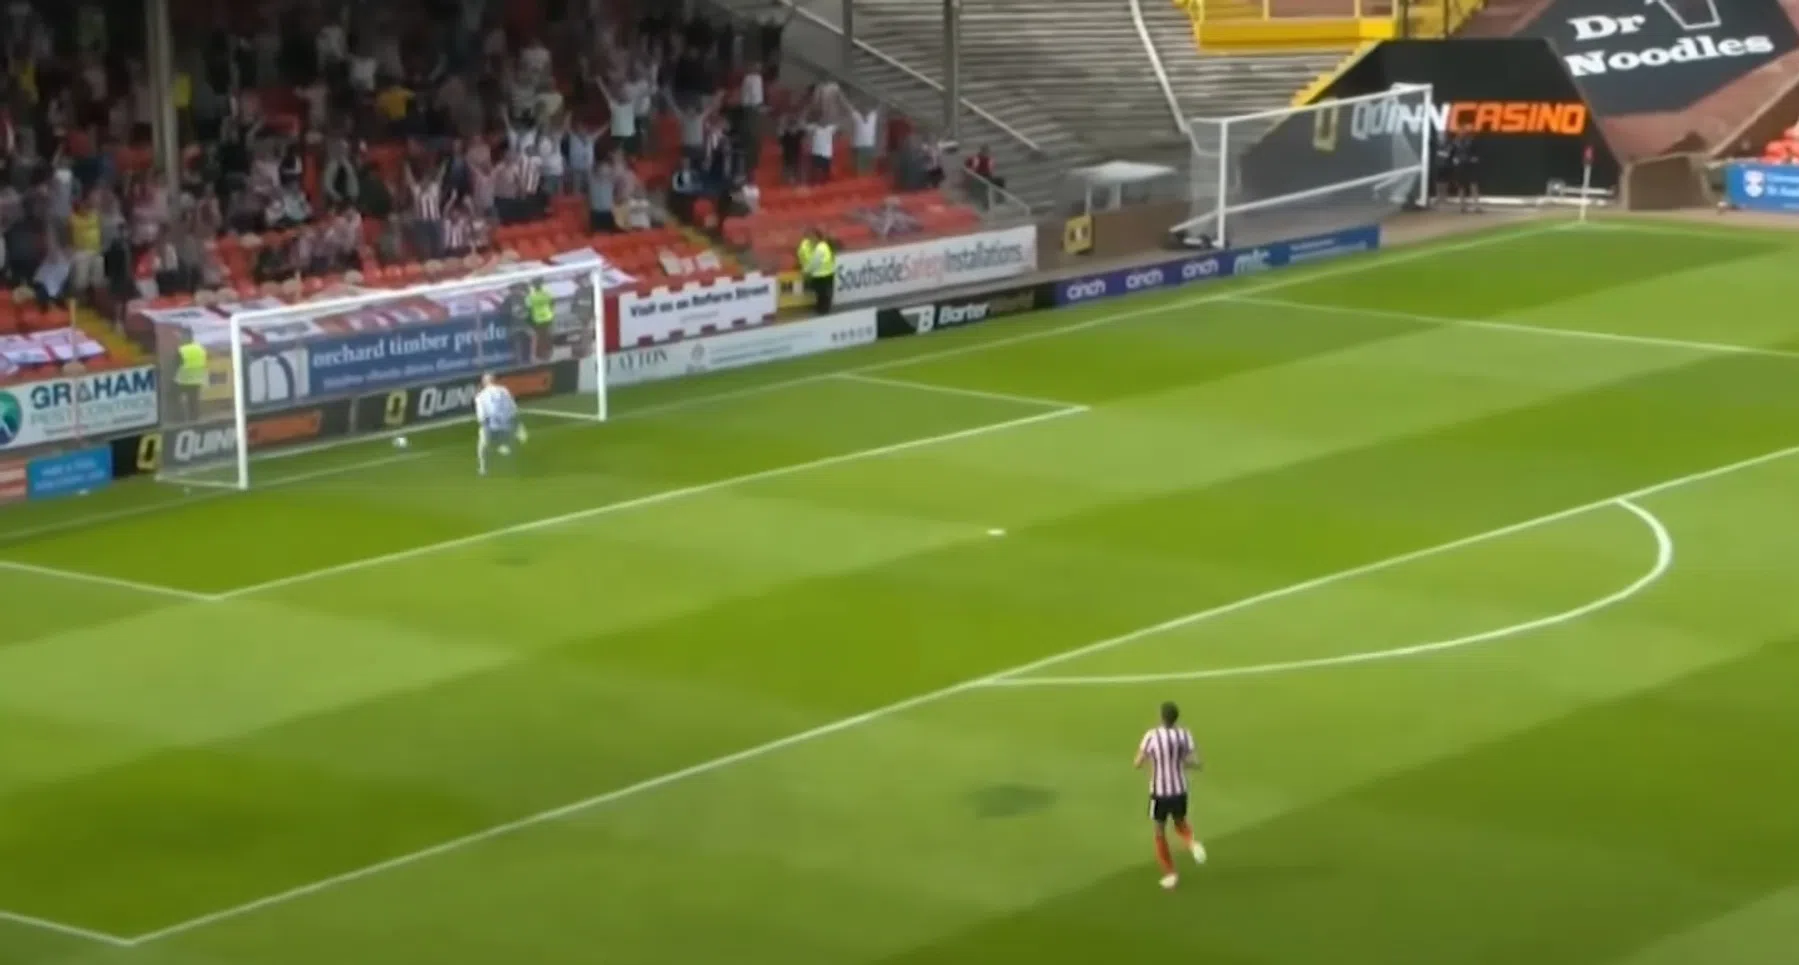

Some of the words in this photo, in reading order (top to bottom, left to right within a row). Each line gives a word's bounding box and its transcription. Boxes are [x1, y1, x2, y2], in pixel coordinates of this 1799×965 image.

[1568, 14, 1646, 41] Dr
[1564, 35, 1775, 77] Noodles
[1126, 267, 1163, 290] cinch
[1182, 257, 1219, 281] cinch
[735, 284, 769, 298] Street
[1067, 278, 1106, 301] cinch
[938, 303, 989, 326] Barter
[313, 341, 385, 368] orchard
[389, 330, 449, 355] timber
[30, 370, 156, 410] GRAHAM
